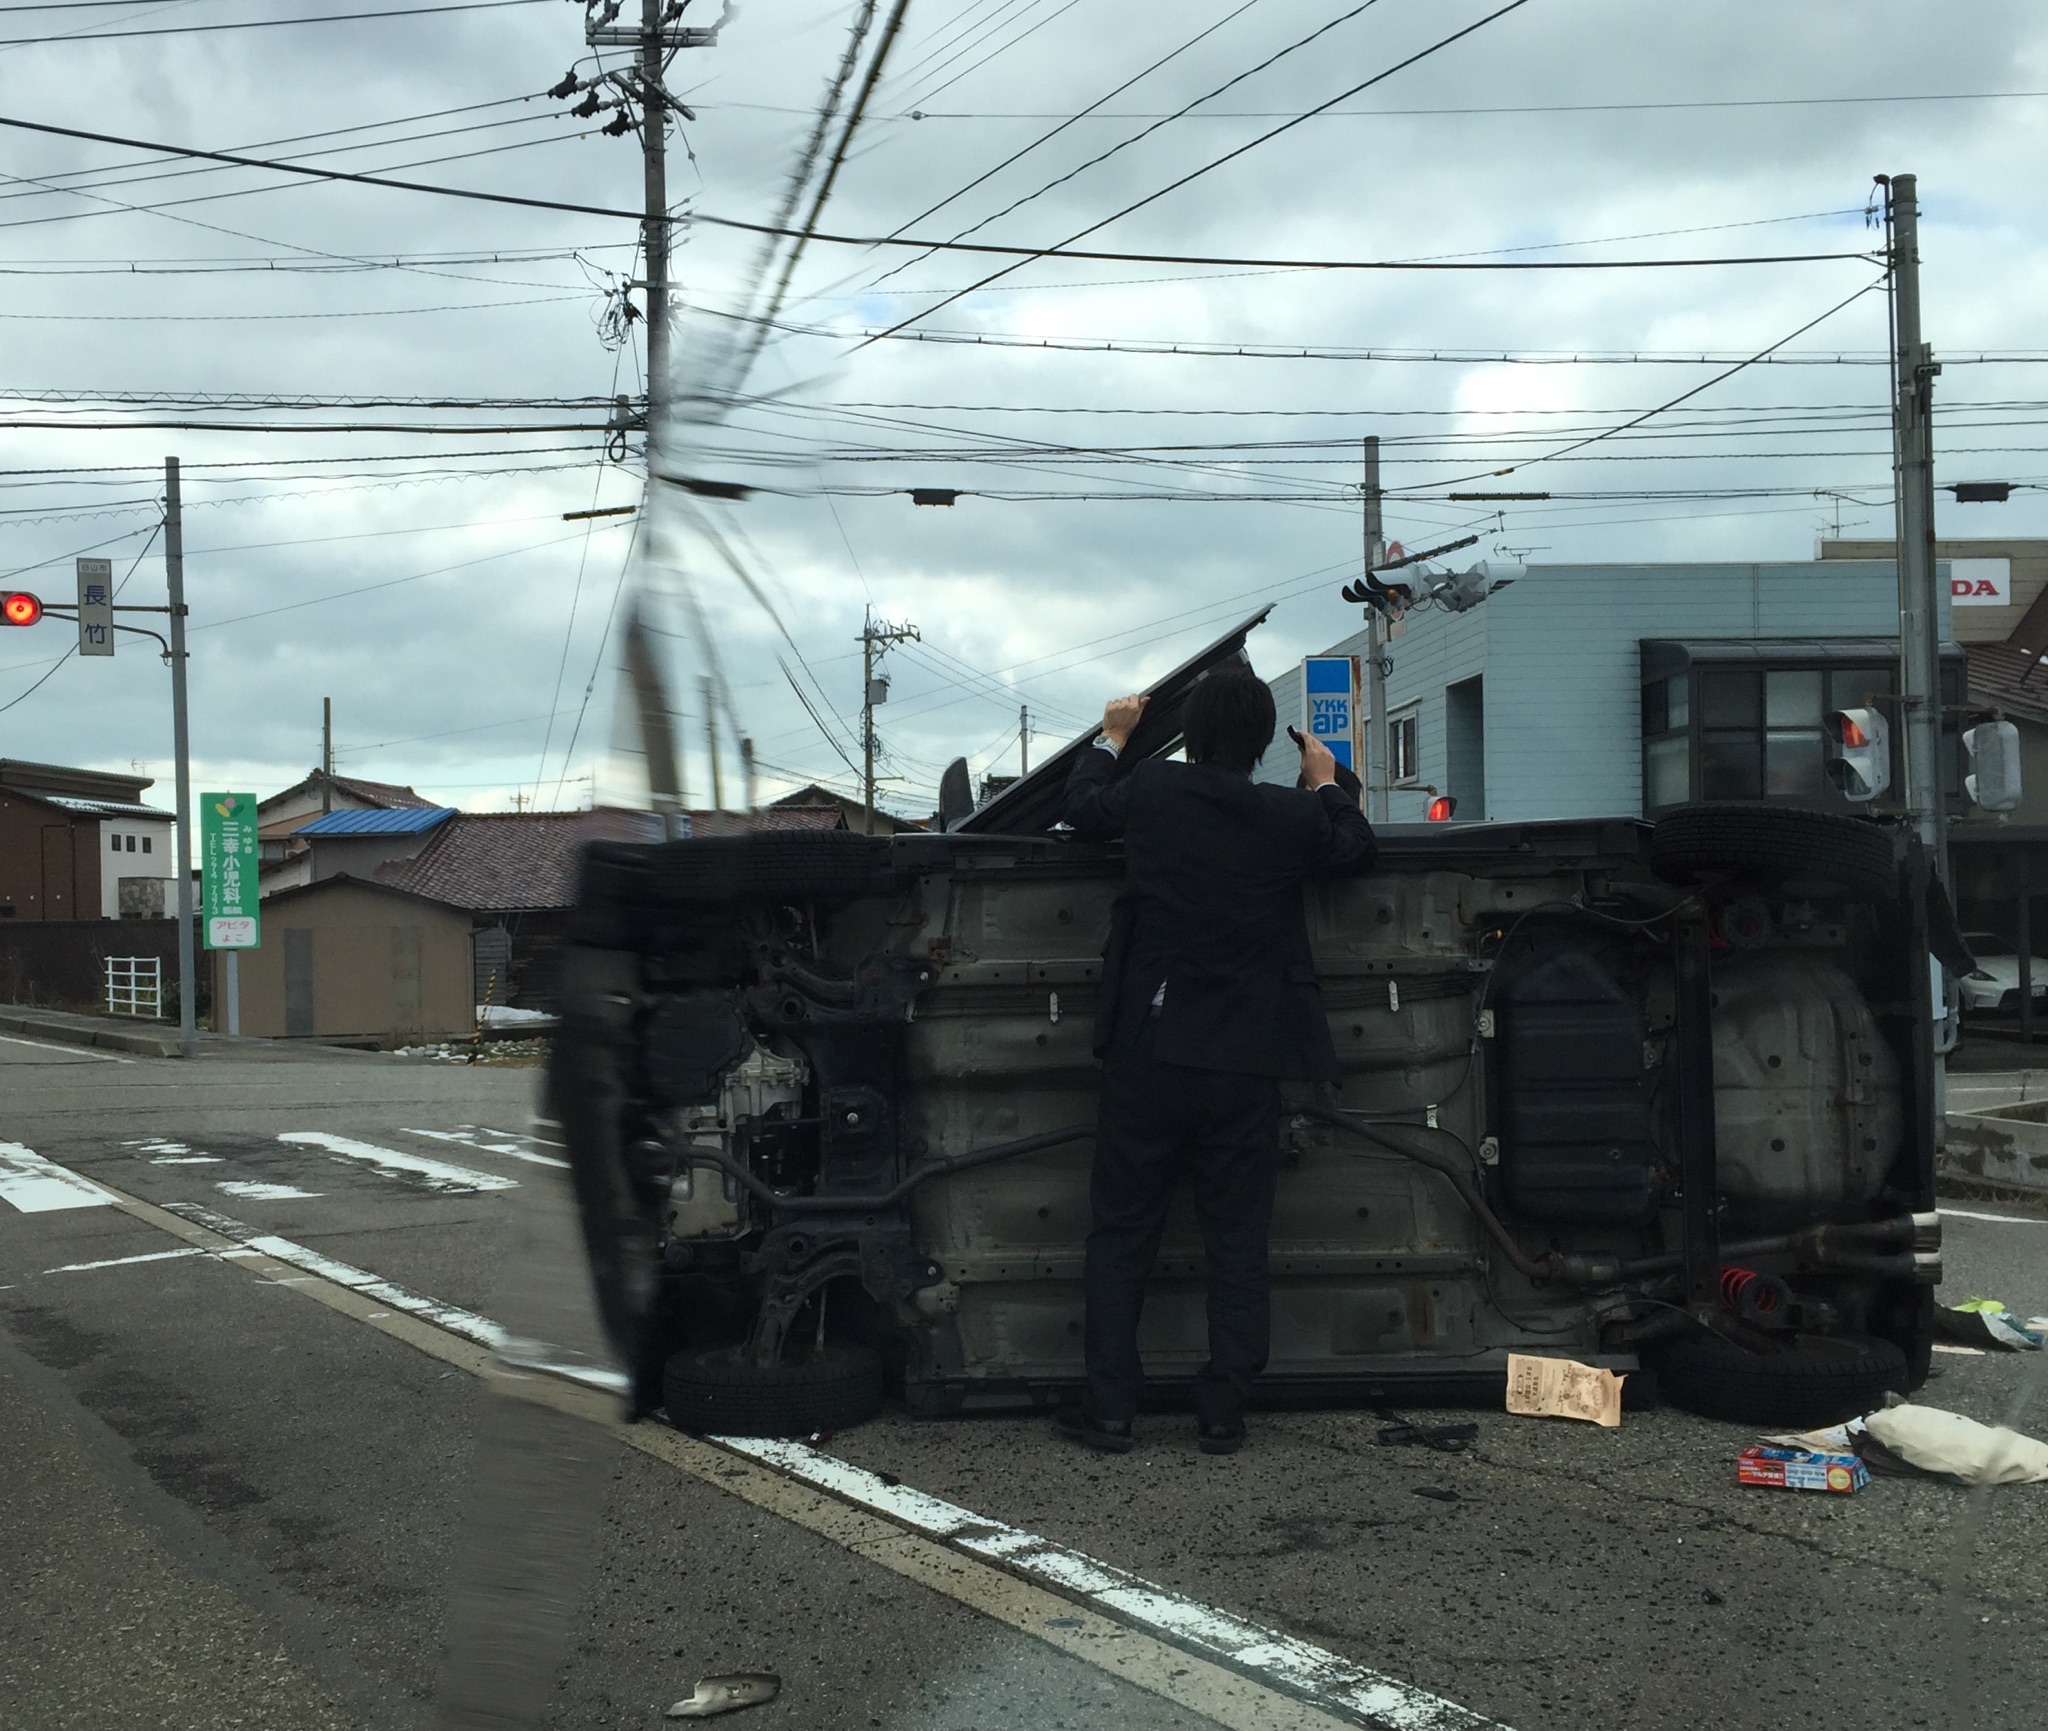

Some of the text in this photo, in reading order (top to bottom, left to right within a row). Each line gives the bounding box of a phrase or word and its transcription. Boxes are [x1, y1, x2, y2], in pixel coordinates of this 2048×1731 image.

[83, 585, 107, 644] 長竹
[1312, 699, 1347, 713] YKK
[1312, 713, 1349, 734] ap
[222, 934, 244, 943] よこ
